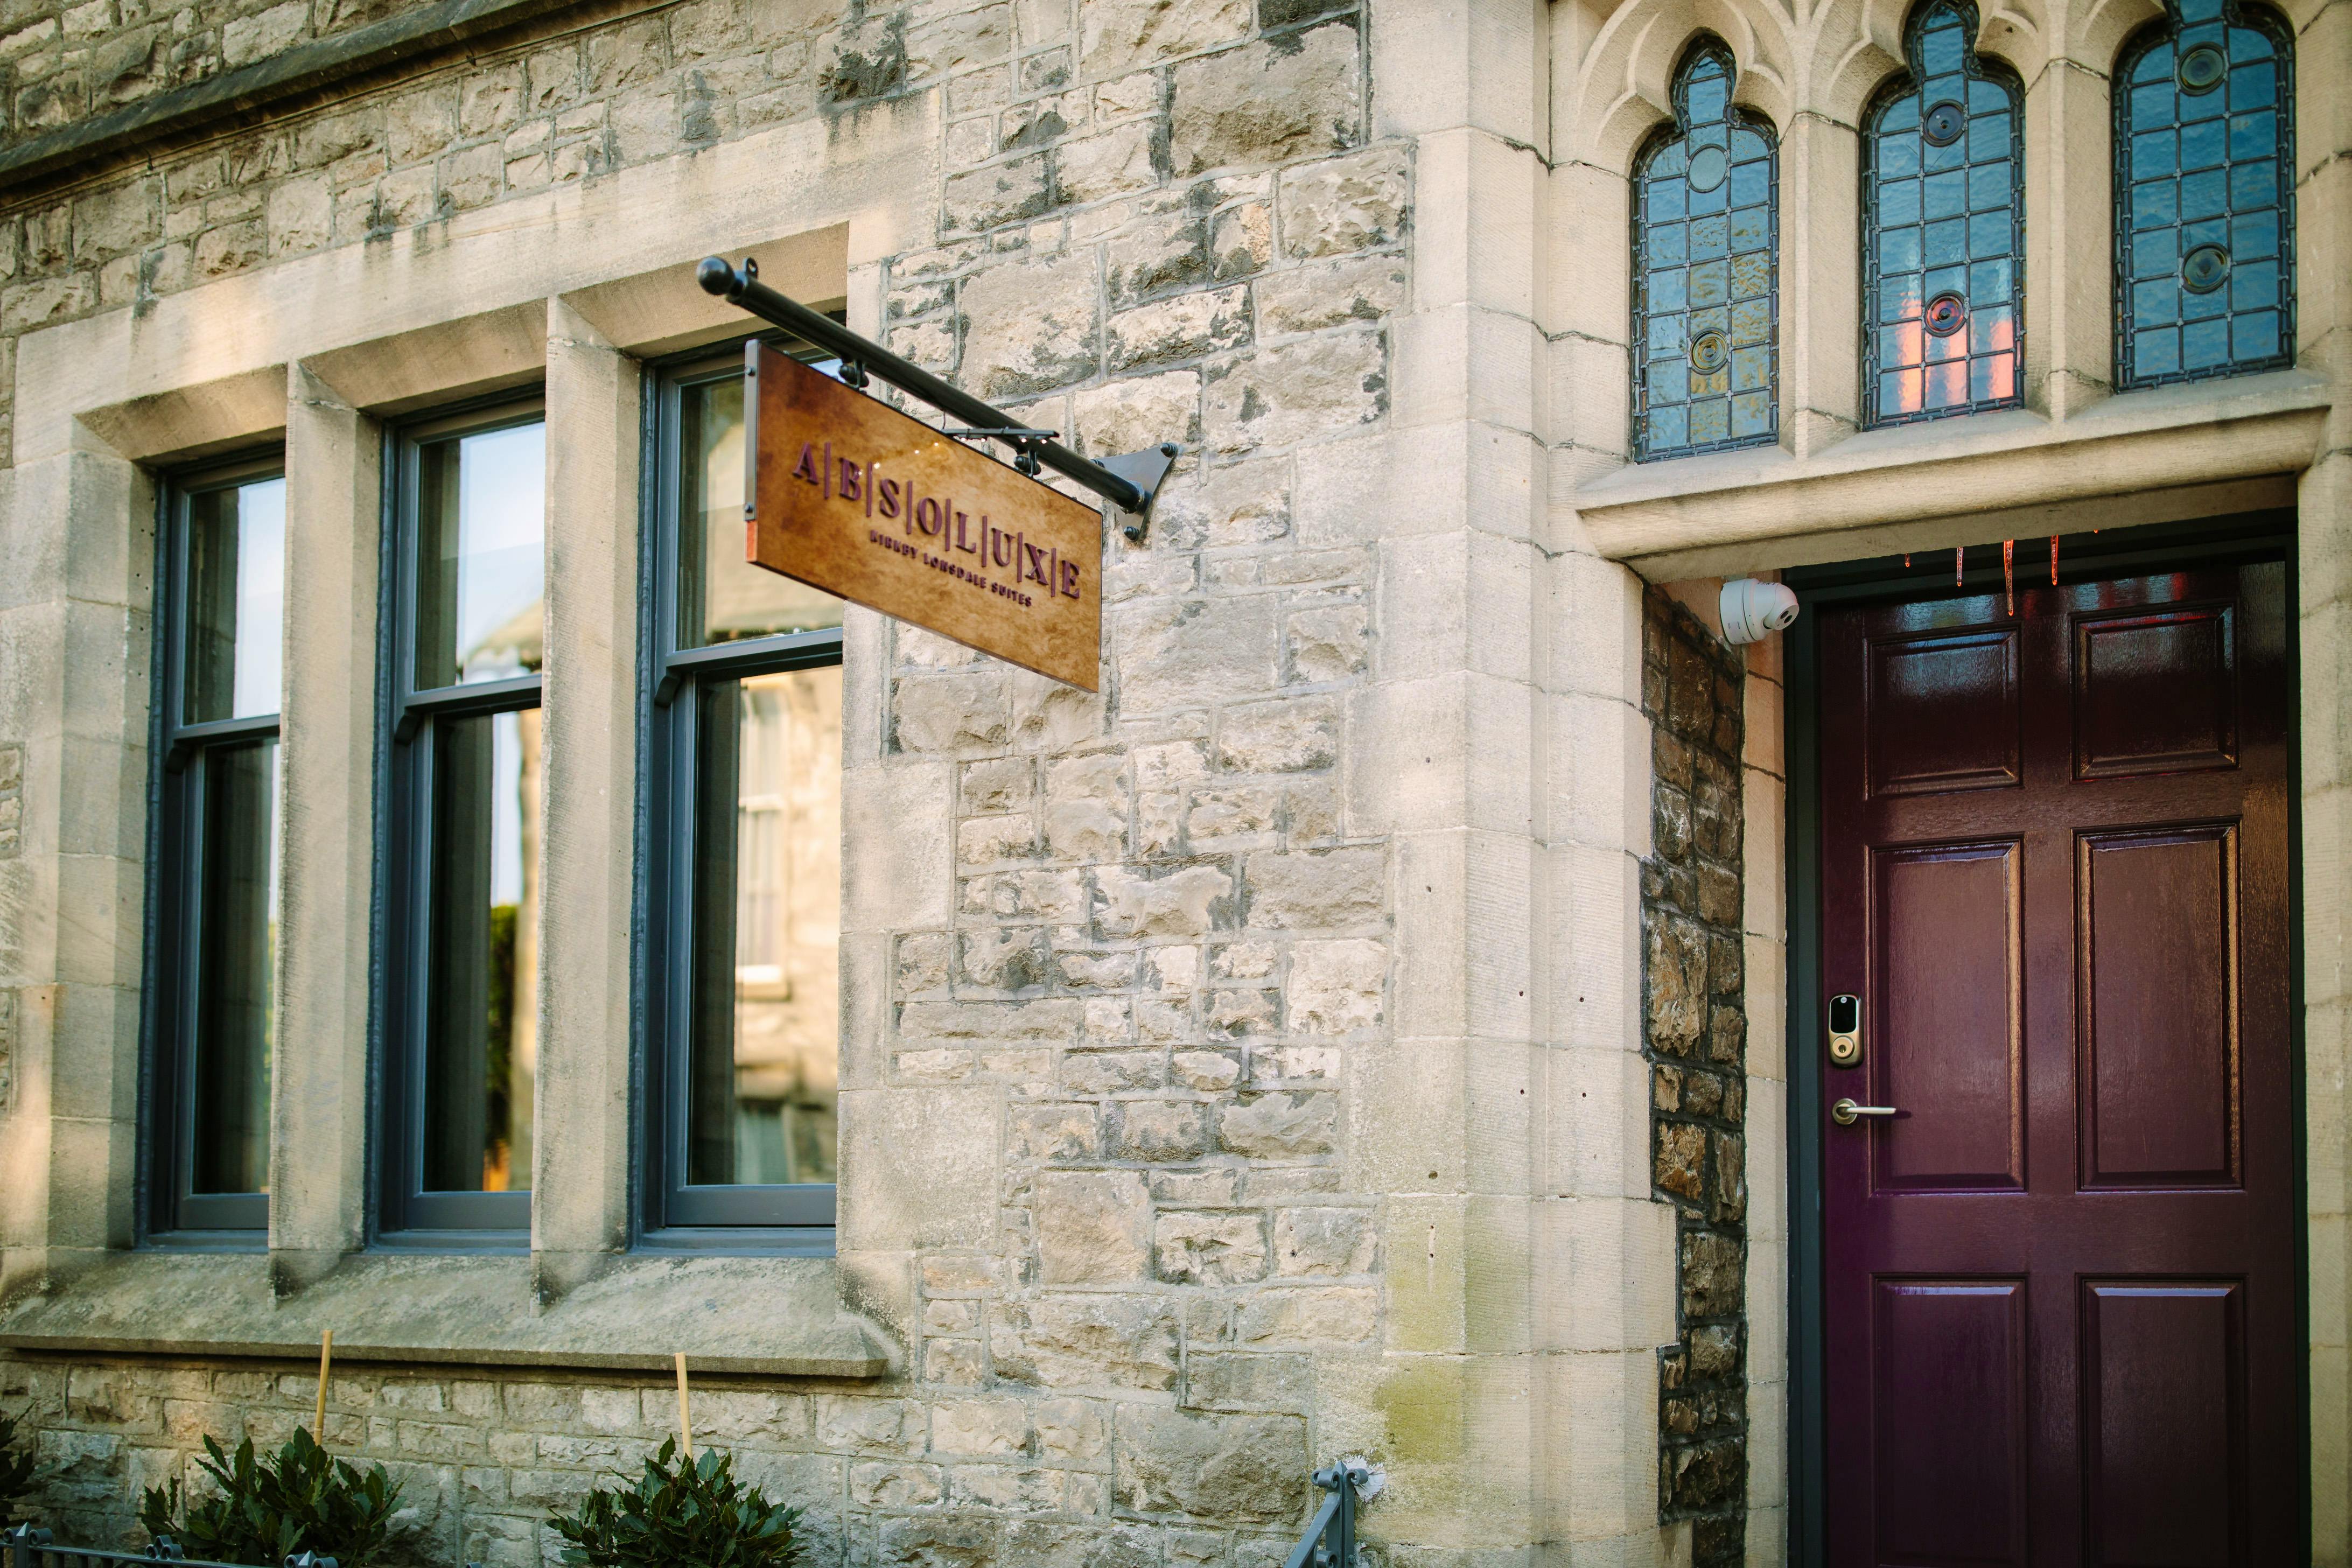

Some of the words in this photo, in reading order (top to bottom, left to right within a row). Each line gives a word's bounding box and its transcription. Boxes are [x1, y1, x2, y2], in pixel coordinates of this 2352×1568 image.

[870, 529, 918, 559] KIRKBY
[923, 552, 986, 589] LONSDALE
[991, 582, 1032, 607] SUITES
